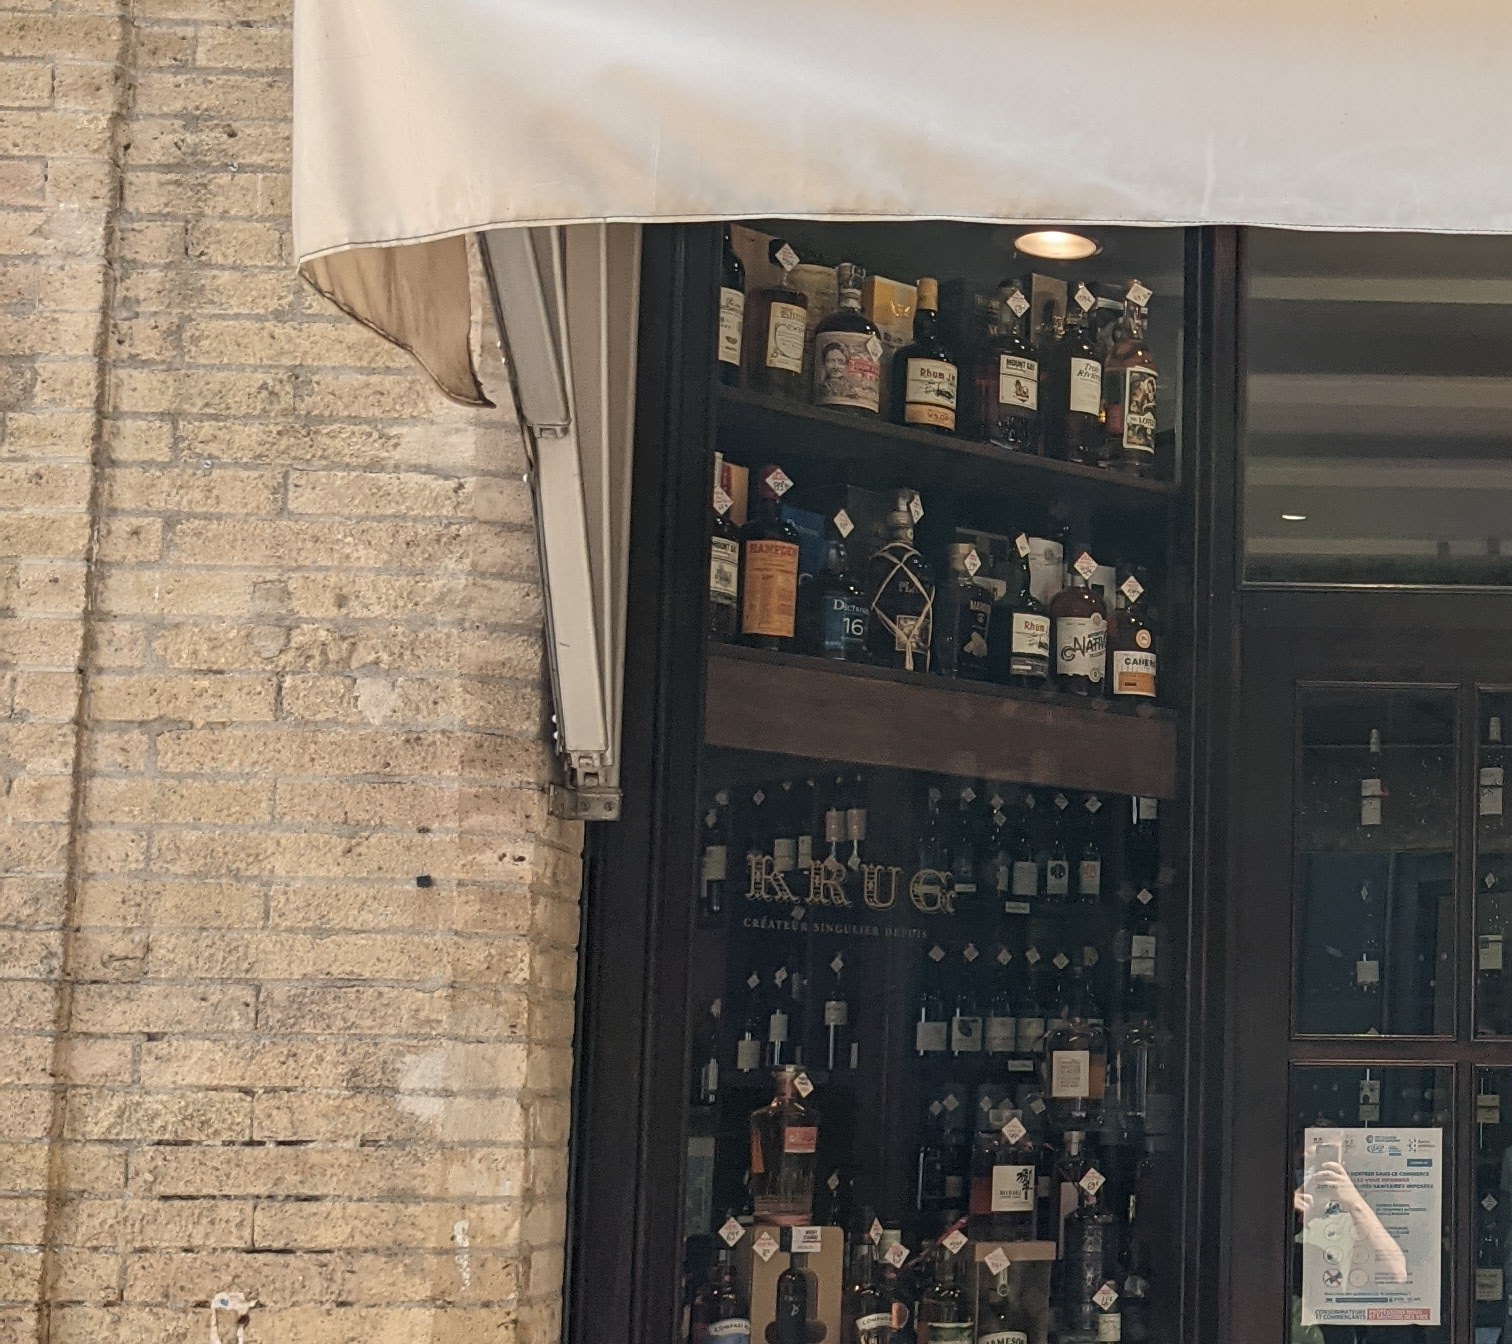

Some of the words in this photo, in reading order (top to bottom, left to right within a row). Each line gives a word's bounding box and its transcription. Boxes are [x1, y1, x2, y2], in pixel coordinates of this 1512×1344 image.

[843, 617, 864, 636] 16
[744, 853, 956, 916] KRUG
[743, 917, 808, 932] CRÉATEUR
[813, 922, 880, 937] SINGULIER
